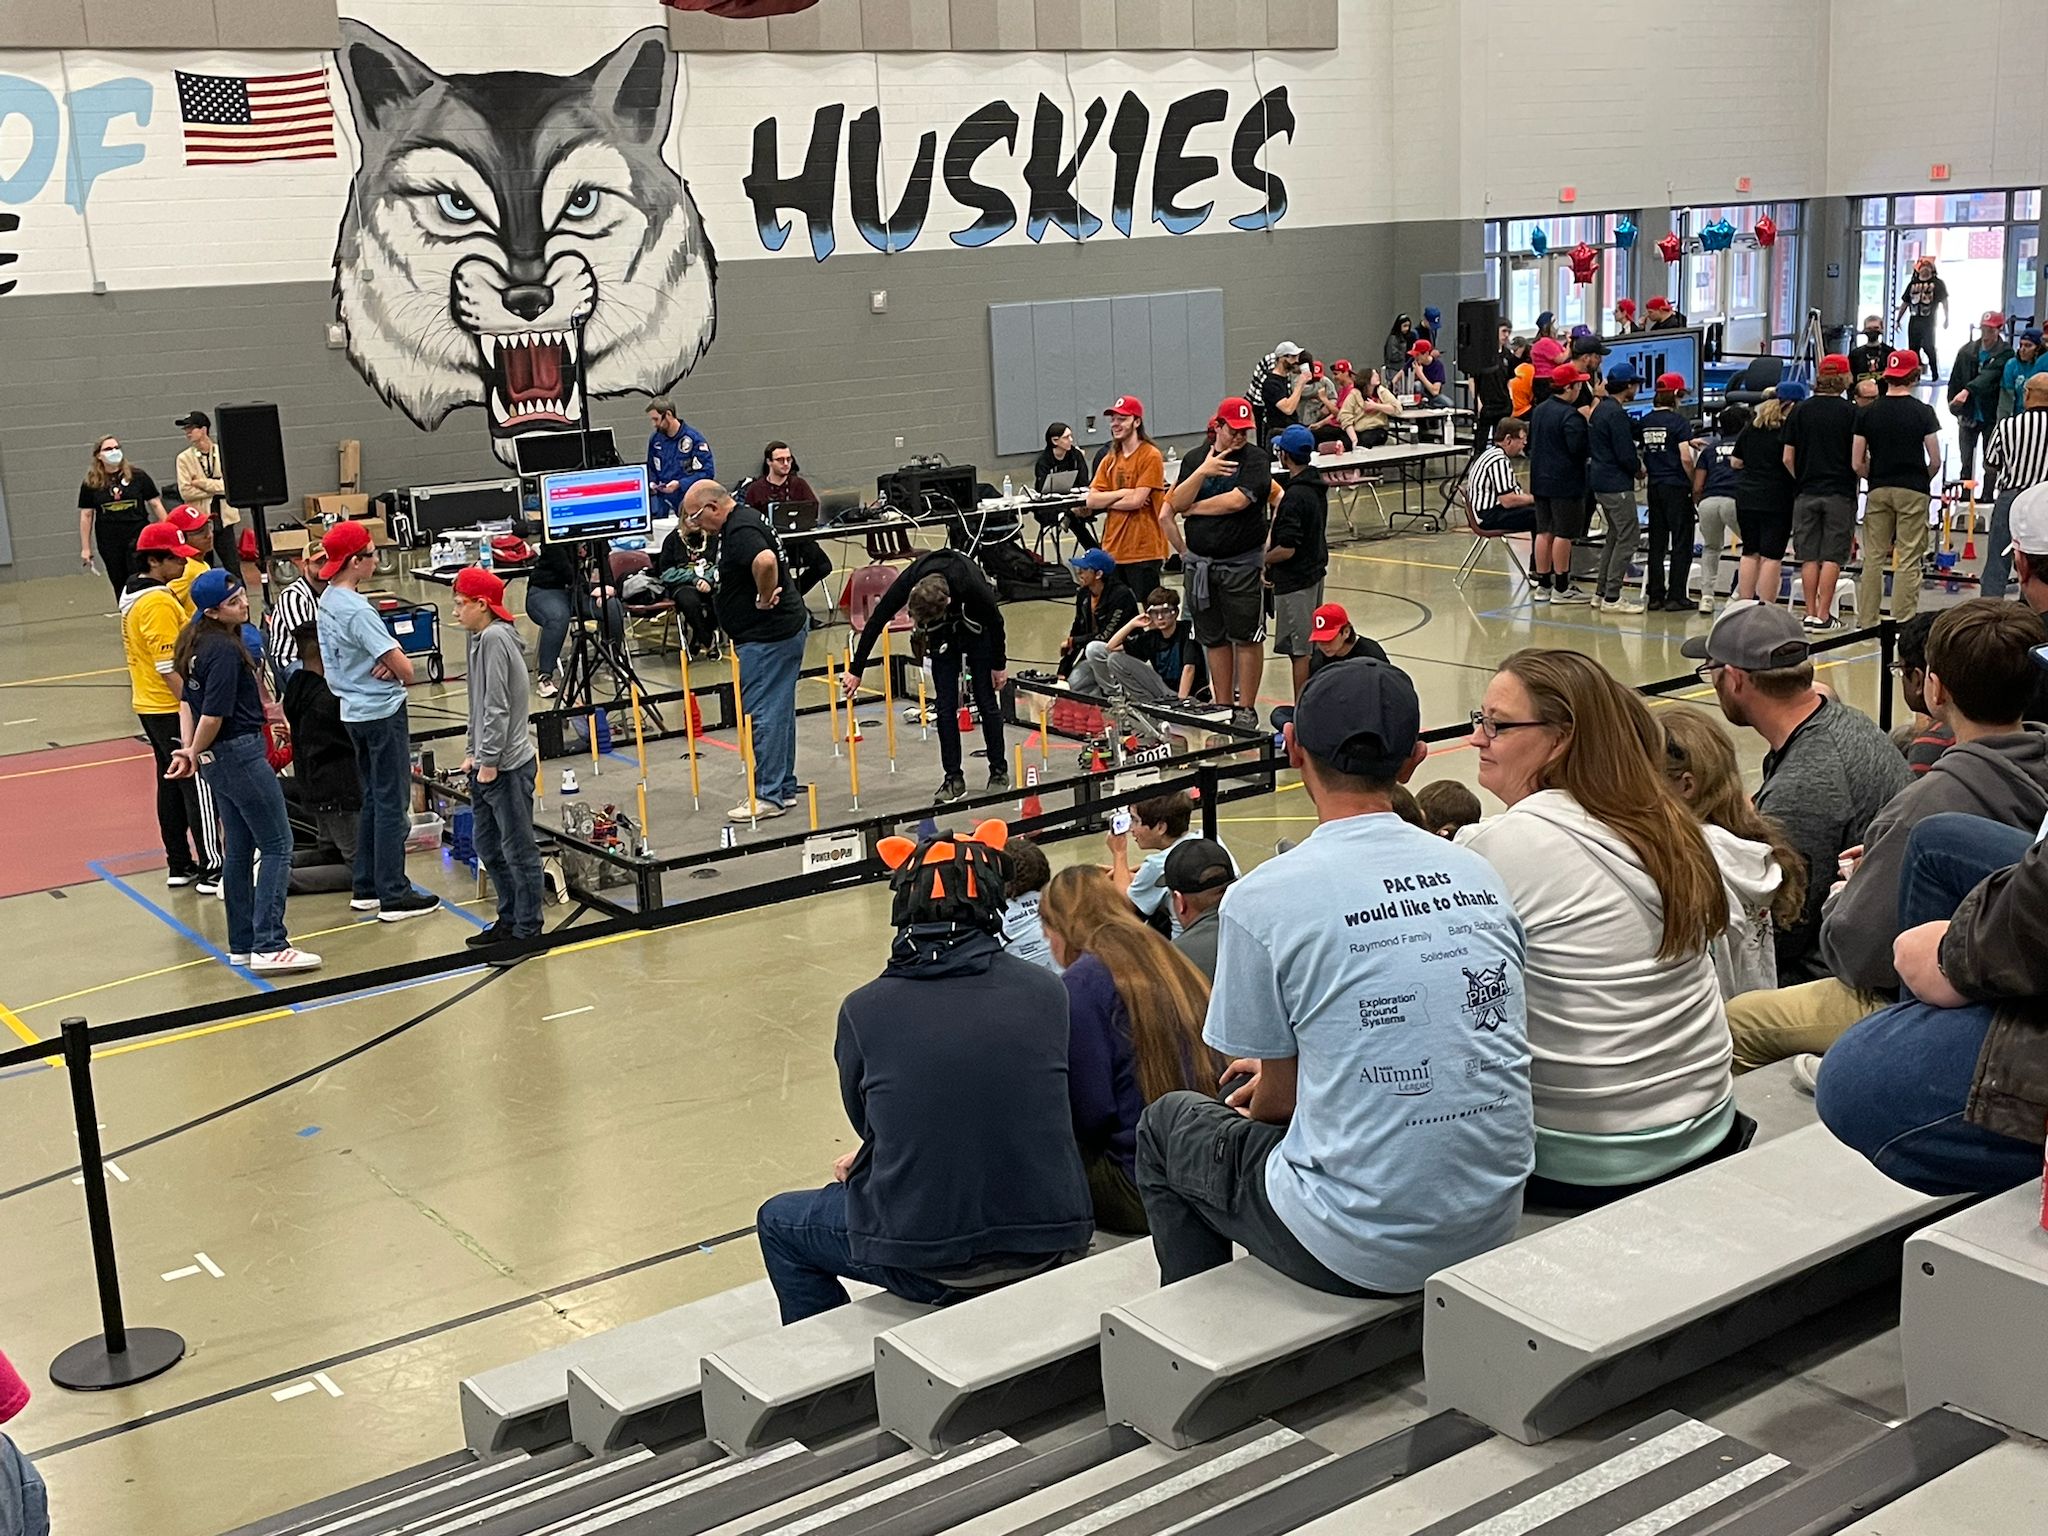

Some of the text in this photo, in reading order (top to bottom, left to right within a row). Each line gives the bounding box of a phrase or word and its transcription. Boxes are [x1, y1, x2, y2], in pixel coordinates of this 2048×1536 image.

[742, 85, 1296, 263] HUSKIES
[1889, 355, 1899, 368] D
[1114, 397, 1124, 408] D
[1239, 405, 1249, 418] D
[185, 506, 200, 519] D
[1315, 615, 1326, 629] D
[1383, 872, 1451, 893] PAC Rats
[1345, 889, 1499, 927] would like to thank:
[1448, 924, 1472, 935] Barry
[1349, 931, 1432, 953] Raymond Family
[1420, 946, 1469, 963] Solidworks
[1467, 981, 1509, 1007] PACA
[1359, 994, 1416, 1009] Exploration
[1360, 1005, 1398, 1018] Ground
[1361, 1015, 1406, 1029] Systems
[1360, 1059, 1430, 1083] Alumni
